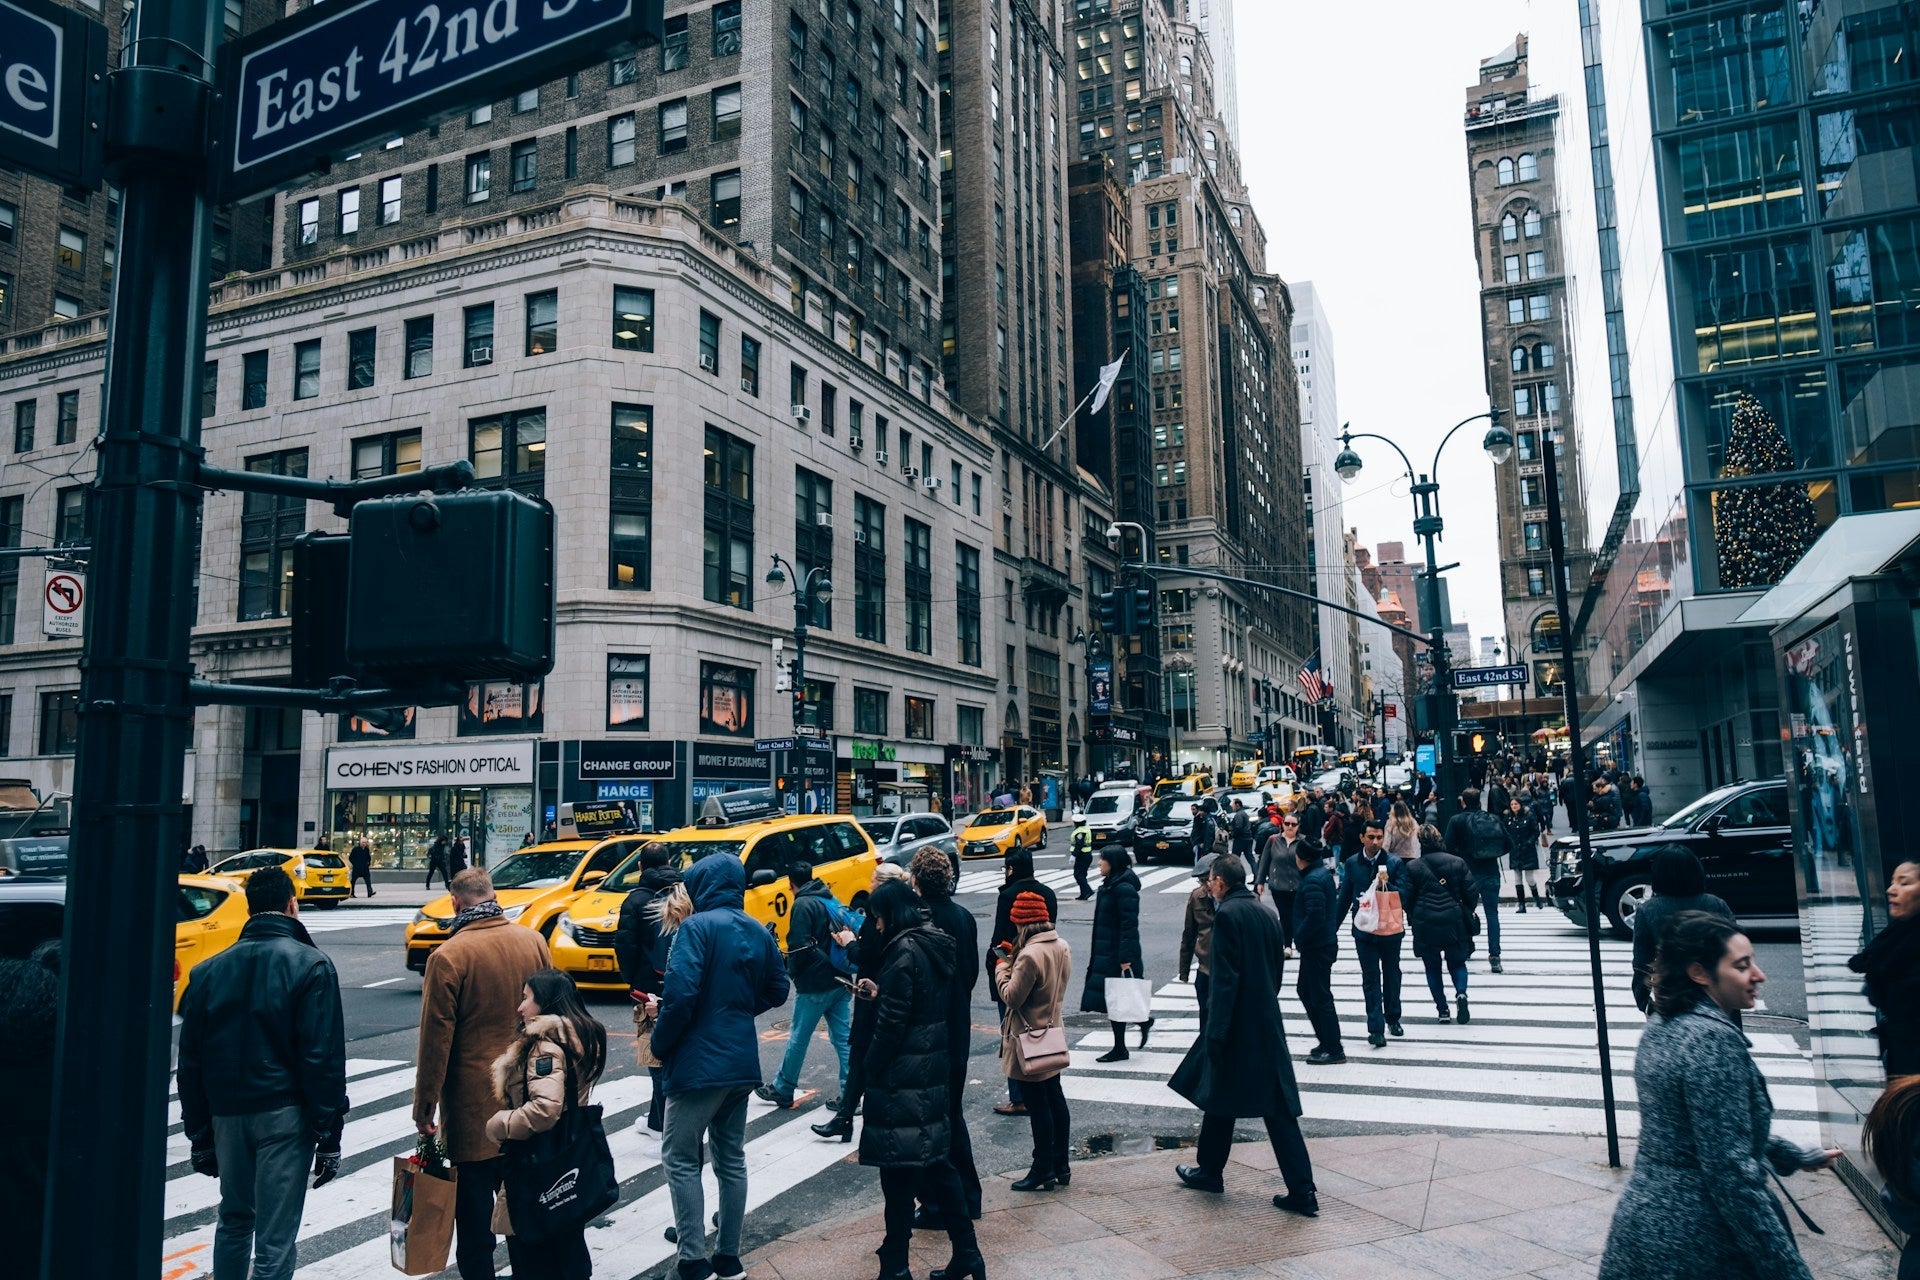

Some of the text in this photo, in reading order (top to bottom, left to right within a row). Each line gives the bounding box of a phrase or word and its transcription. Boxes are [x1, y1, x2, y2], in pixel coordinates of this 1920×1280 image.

[252, 0, 519, 140] East 42nd
[0, 53, 48, 111] e
[1458, 669, 1523, 684] East 42nd St
[1844, 632, 1868, 794] Newsstand
[337, 757, 520, 777] COHEN'S FASHION OPTICAL
[583, 760, 672, 771] CHANGE GROUP
[698, 755, 767, 768] MONEY EXCHANGE
[575, 809, 623, 822] HARRY POTTER
